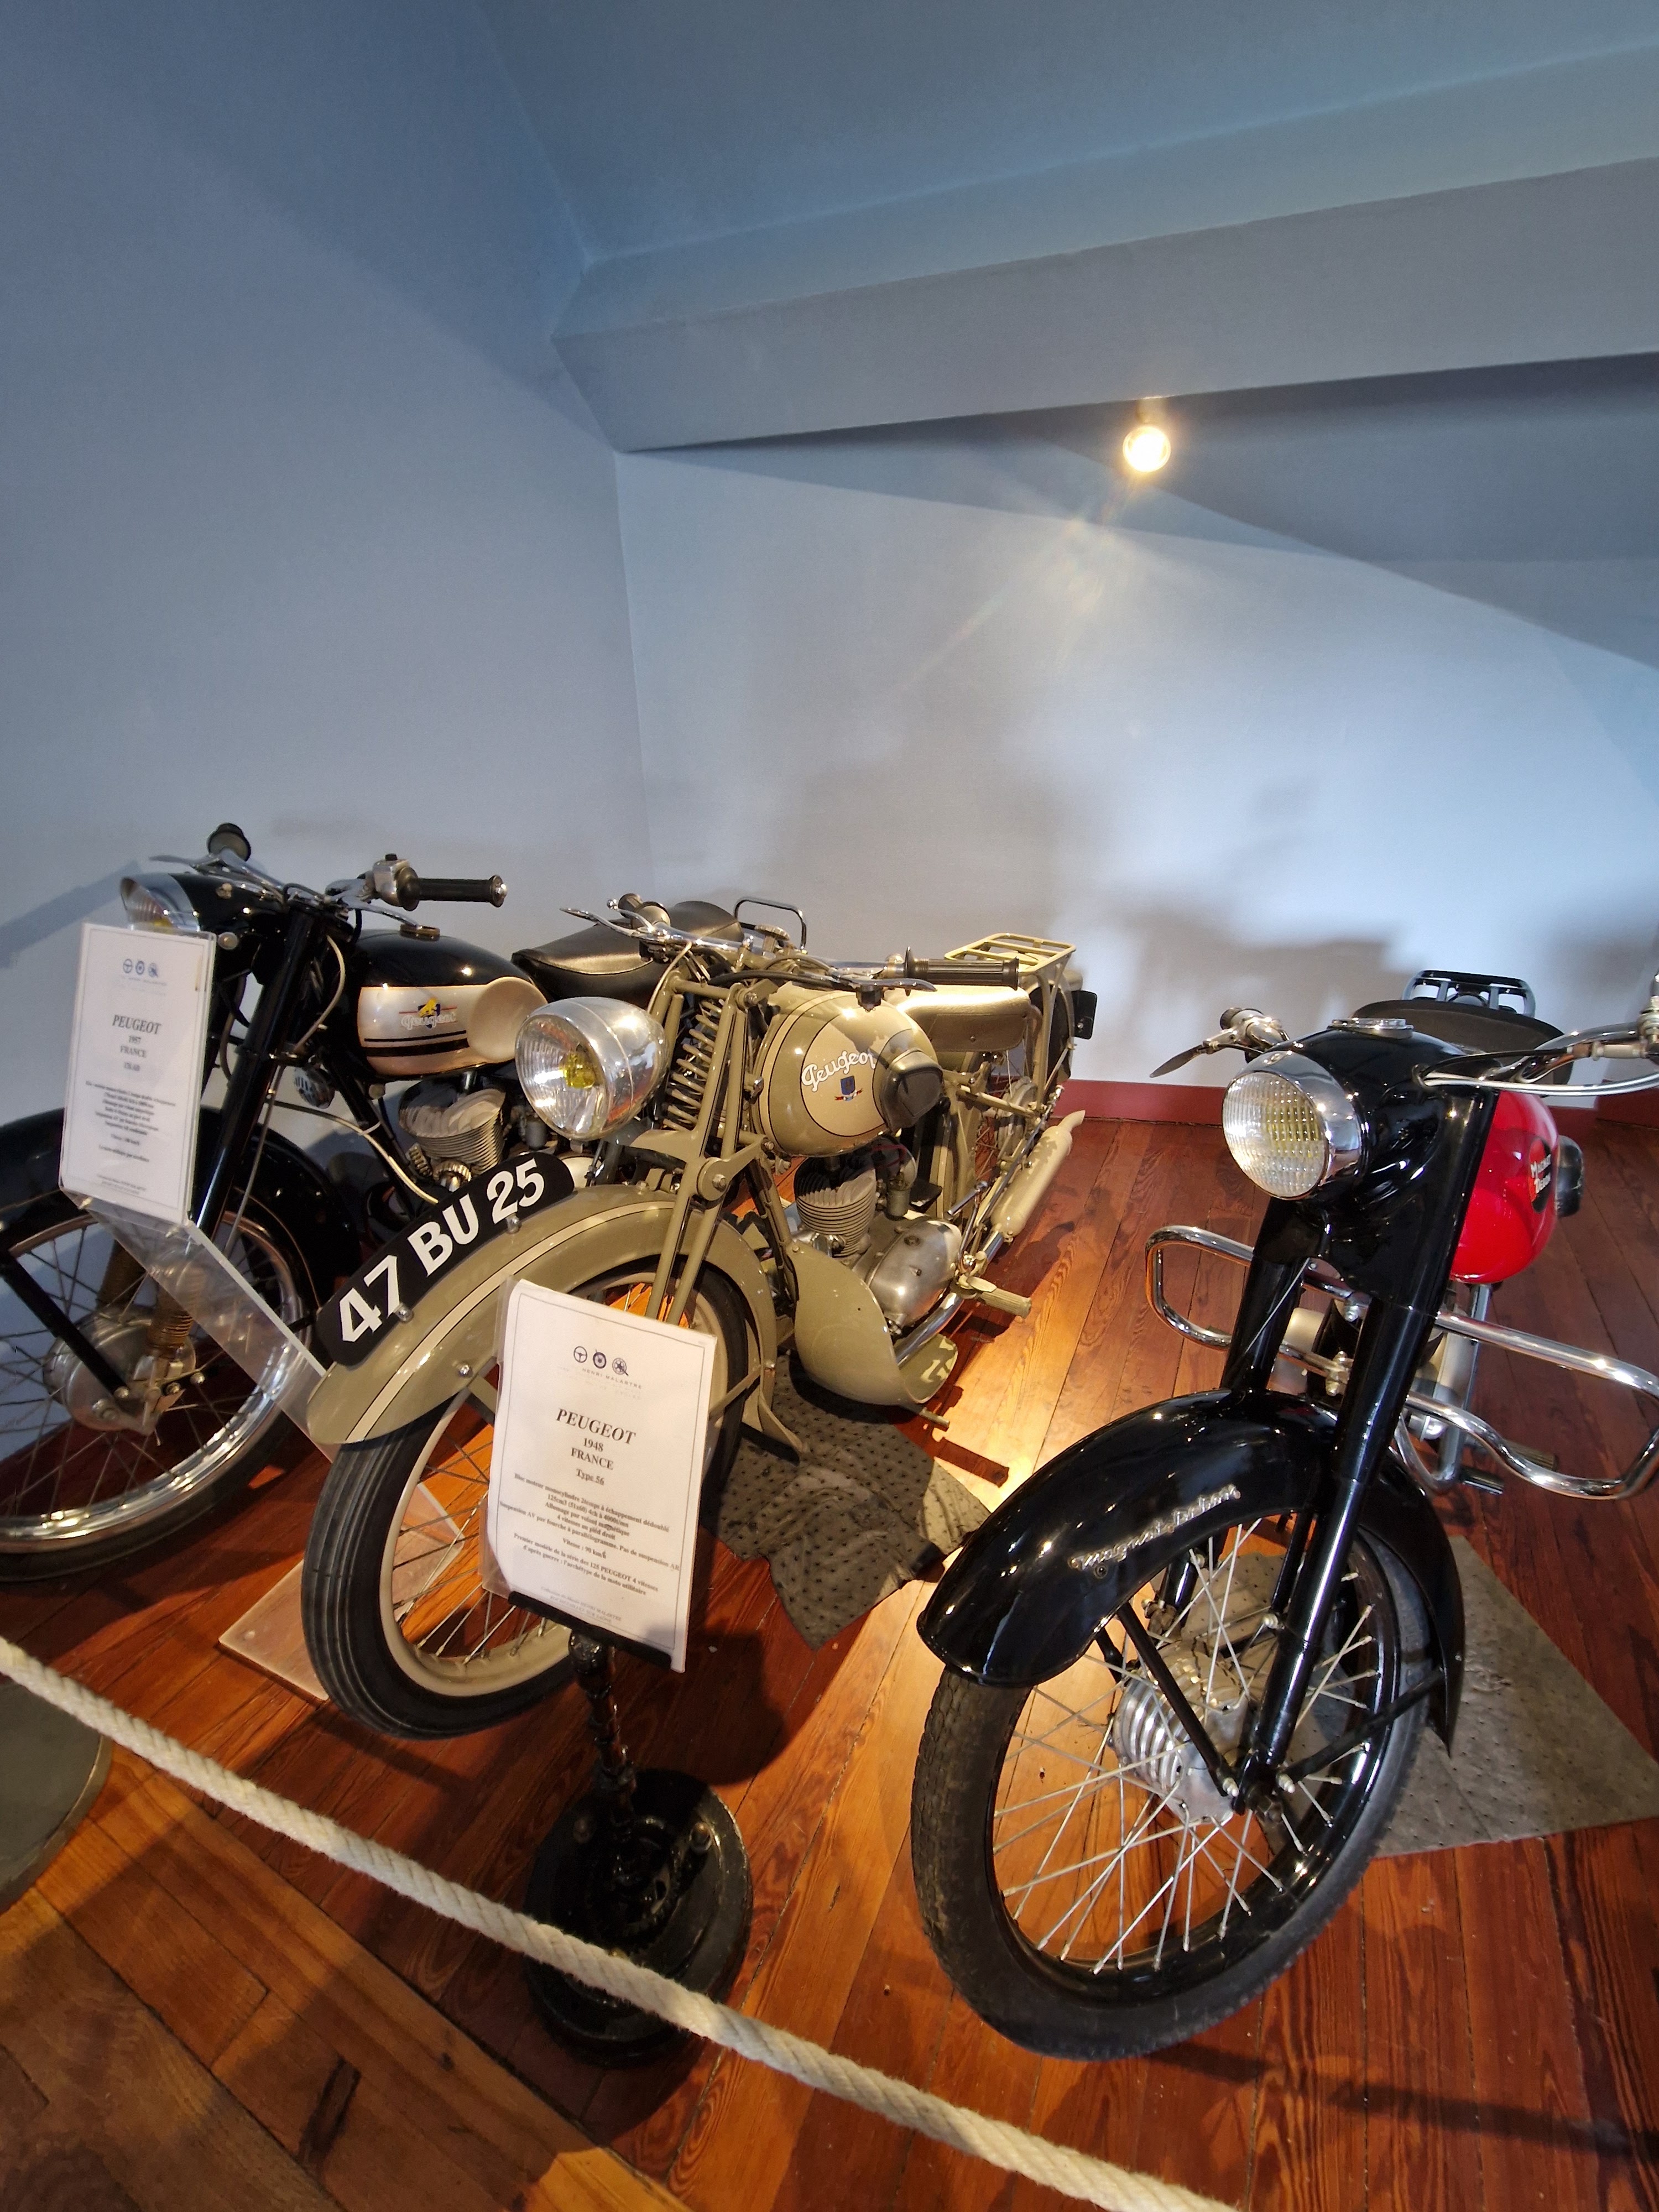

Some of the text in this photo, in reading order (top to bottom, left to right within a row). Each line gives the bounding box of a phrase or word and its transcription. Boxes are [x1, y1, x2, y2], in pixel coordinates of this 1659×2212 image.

[112, 1014, 161, 1035] PEUGEOT
[401, 1011, 456, 1030] Peugeot
[120, 1045, 147, 1058] FRANCE
[801, 1050, 875, 1092] Peugeot
[340, 1158, 545, 1343] 47 BU 25
[582, 1368, 602, 1377] HENRI
[556, 1408, 636, 1444] PEUGEOT
[583, 1438, 603, 1452] 1948
[571, 1447, 614, 1470] FRANCE
[576, 1468, 604, 1486] Type 56
[525, 1479, 544, 1489] moteur
[545, 1486, 580, 1502] monocylindre
[581, 1498, 600, 1510] 2temps
[605, 1506, 642, 1524] échappement
[643, 1519, 670, 1532] dédoublé
[547, 1494, 567, 1506] 125cm3
[588, 1509, 598, 1517] 4ch
[545, 1502, 570, 1516] Allumage
[581, 1516, 598, 1526] volant
[598, 1522, 630, 1536] magnétique
[561, 1516, 581, 1527] vitesses
[602, 1531, 615, 1540] droit
[546, 1519, 567, 1531] fourche
[619, 1545, 629, 1553] Pas
[638, 1553, 669, 1567] suspension
[562, 1537, 581, 1550] Vitesse
[514, 1532, 534, 1545] Premier
[534, 1542, 553, 1552] modèle
[590, 1562, 599, 1570] 125
[601, 1566, 632, 1582] PEUGEOT
[638, 1580, 658, 1592] vitesses
[542, 1552, 560, 1562] guerre
[607, 1578, 622, 1587] moto
[622, 1583, 646, 1595] utilitaire
